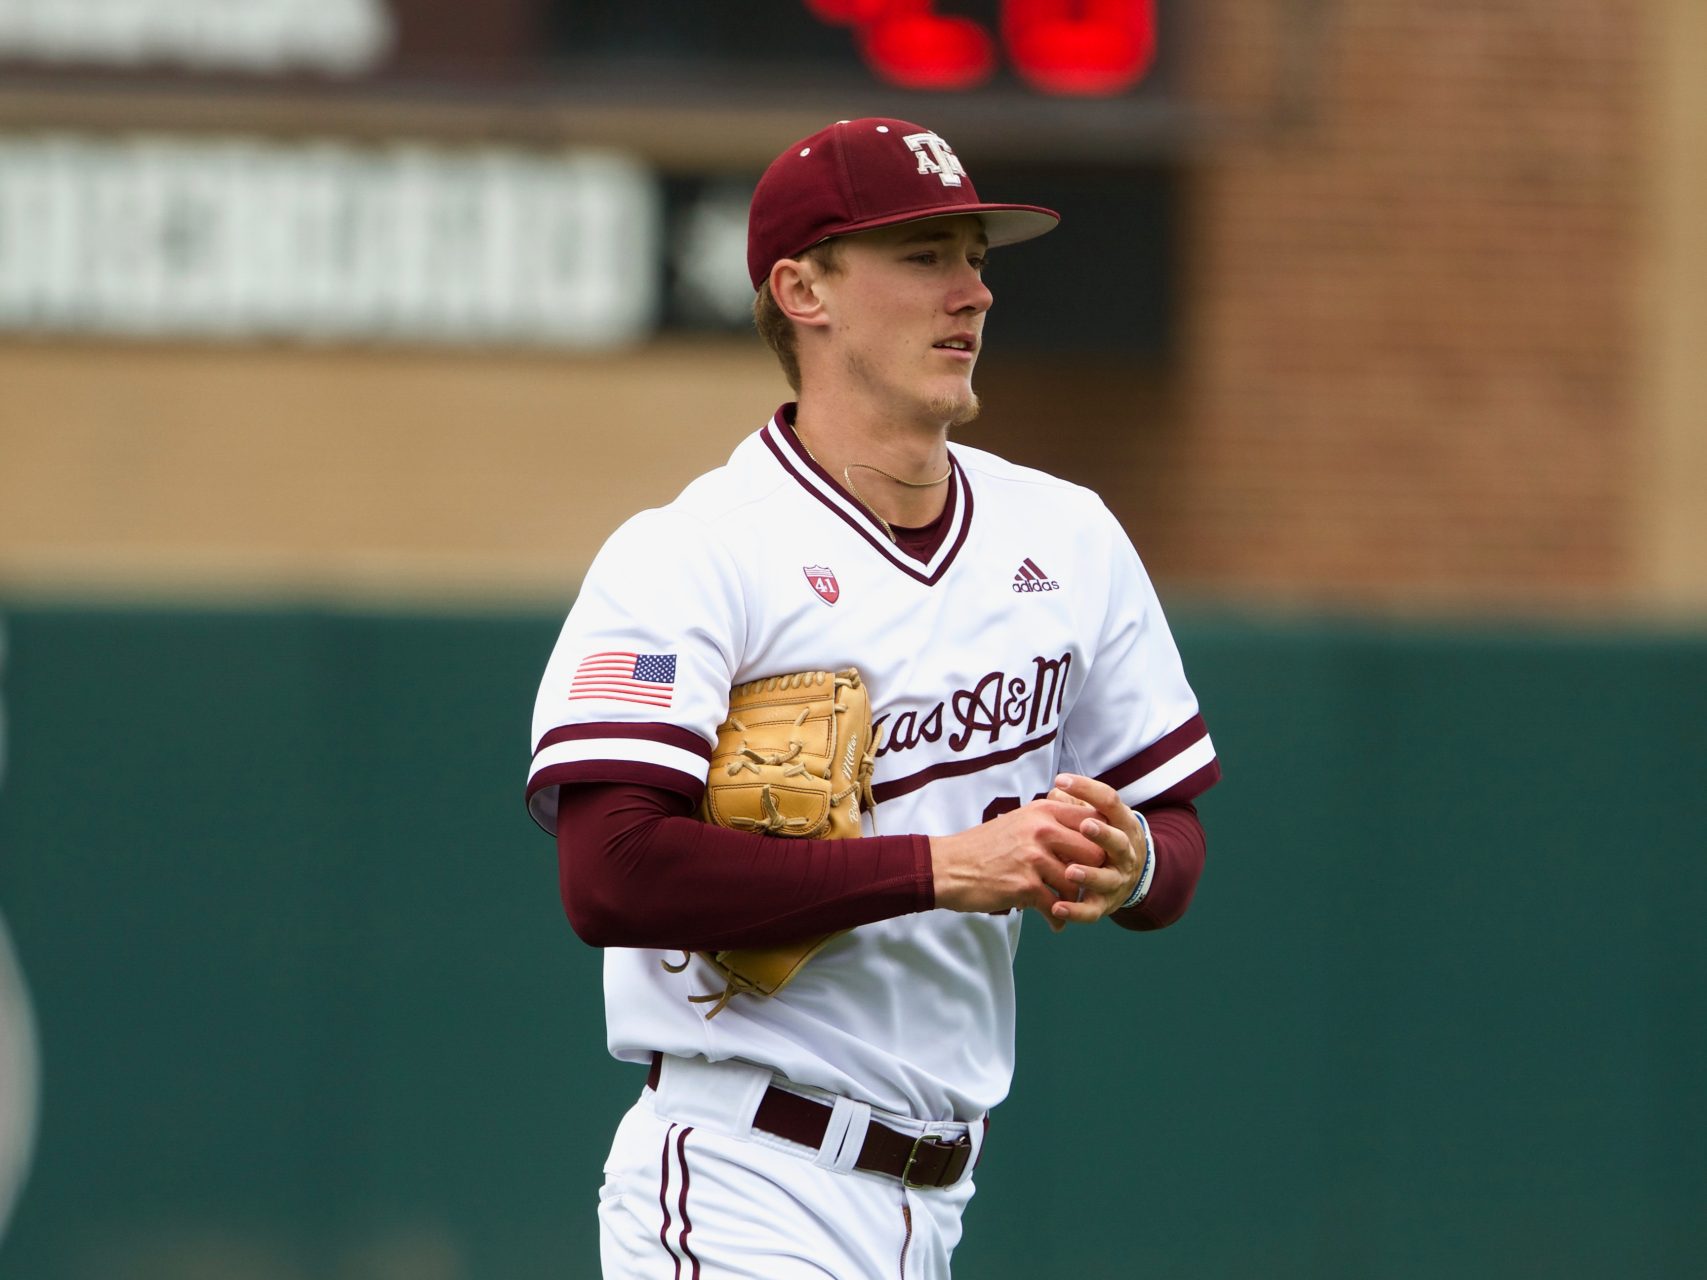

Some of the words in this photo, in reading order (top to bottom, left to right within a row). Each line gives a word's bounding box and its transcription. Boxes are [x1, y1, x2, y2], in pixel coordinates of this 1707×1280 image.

[815, 577, 836, 593] 41
[1012, 579, 1060, 593] adidas
[949, 652, 1072, 752] A&M
